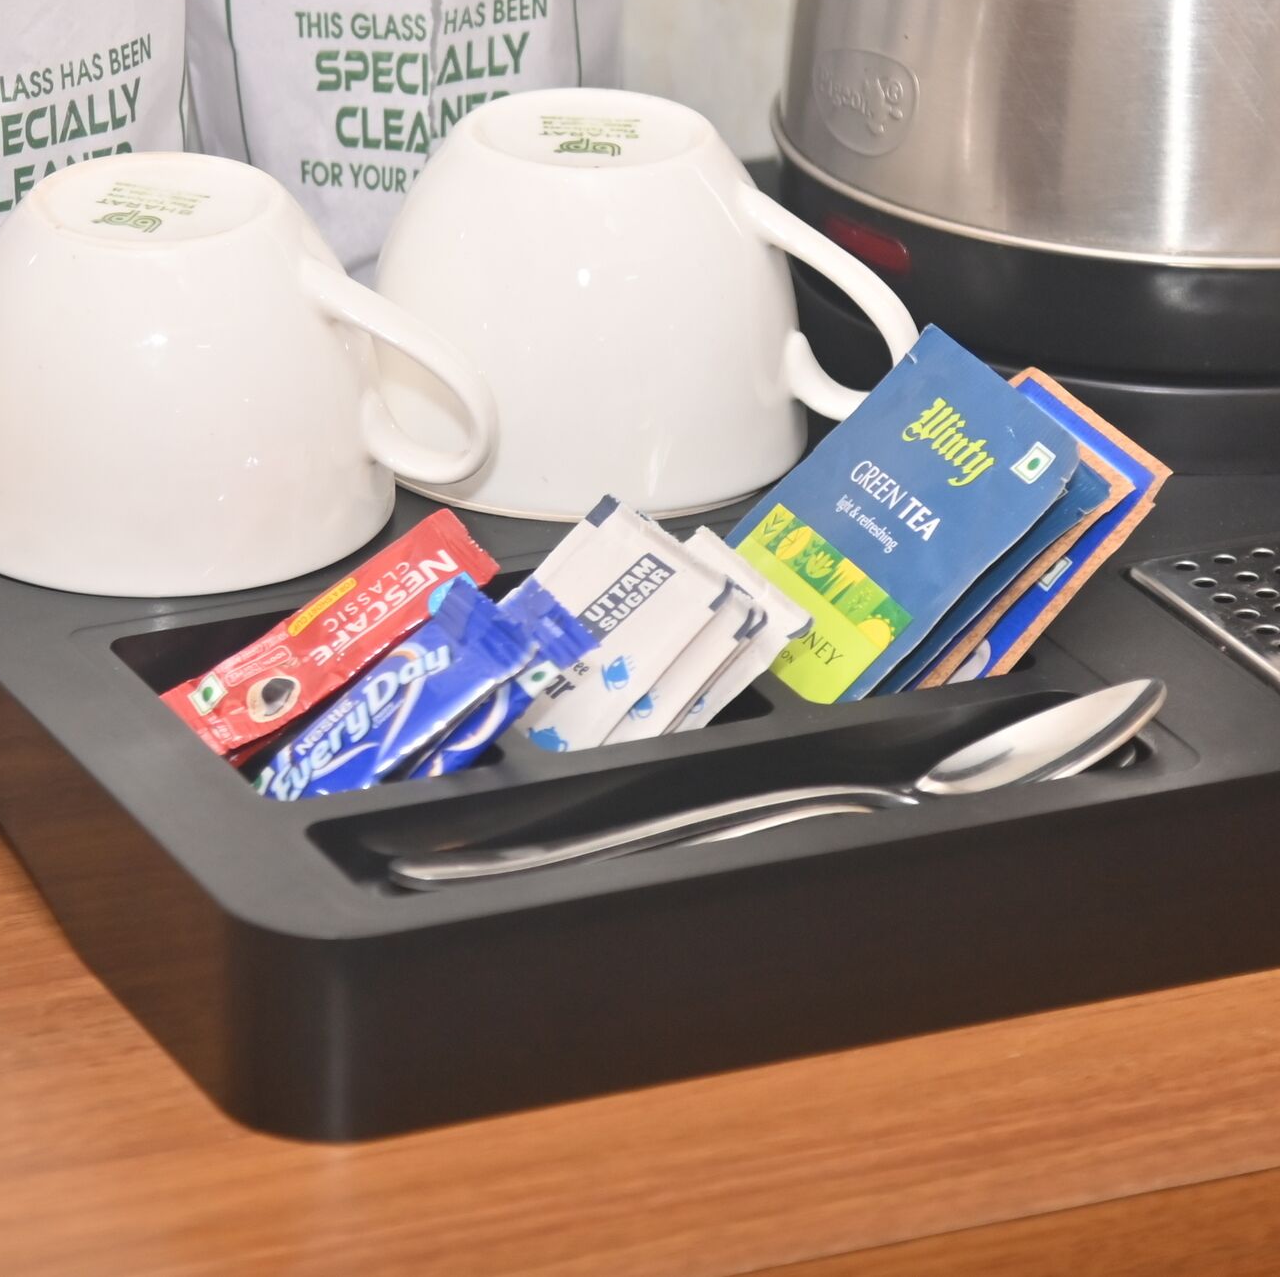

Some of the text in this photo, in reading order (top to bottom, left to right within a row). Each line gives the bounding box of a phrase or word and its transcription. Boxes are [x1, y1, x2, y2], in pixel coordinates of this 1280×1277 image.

[295, 11, 344, 39] THIS
[350, 13, 427, 42] GLASS
[443, 1, 486, 35] HAS
[60, 53, 104, 90] HAS
[108, 33, 152, 76] BEEN
[315, 31, 530, 96] SPECIALLY
[300, 160, 406, 193] FOR YOUR
[836, 494, 899, 554] light & refreshing
[850, 460, 941, 542] GREEN TEA
[323, 561, 410, 633] CLASSIC
[584, 557, 658, 622] UTTAM
[599, 568, 670, 632] SUGAR
[798, 631, 844, 666] NEY
